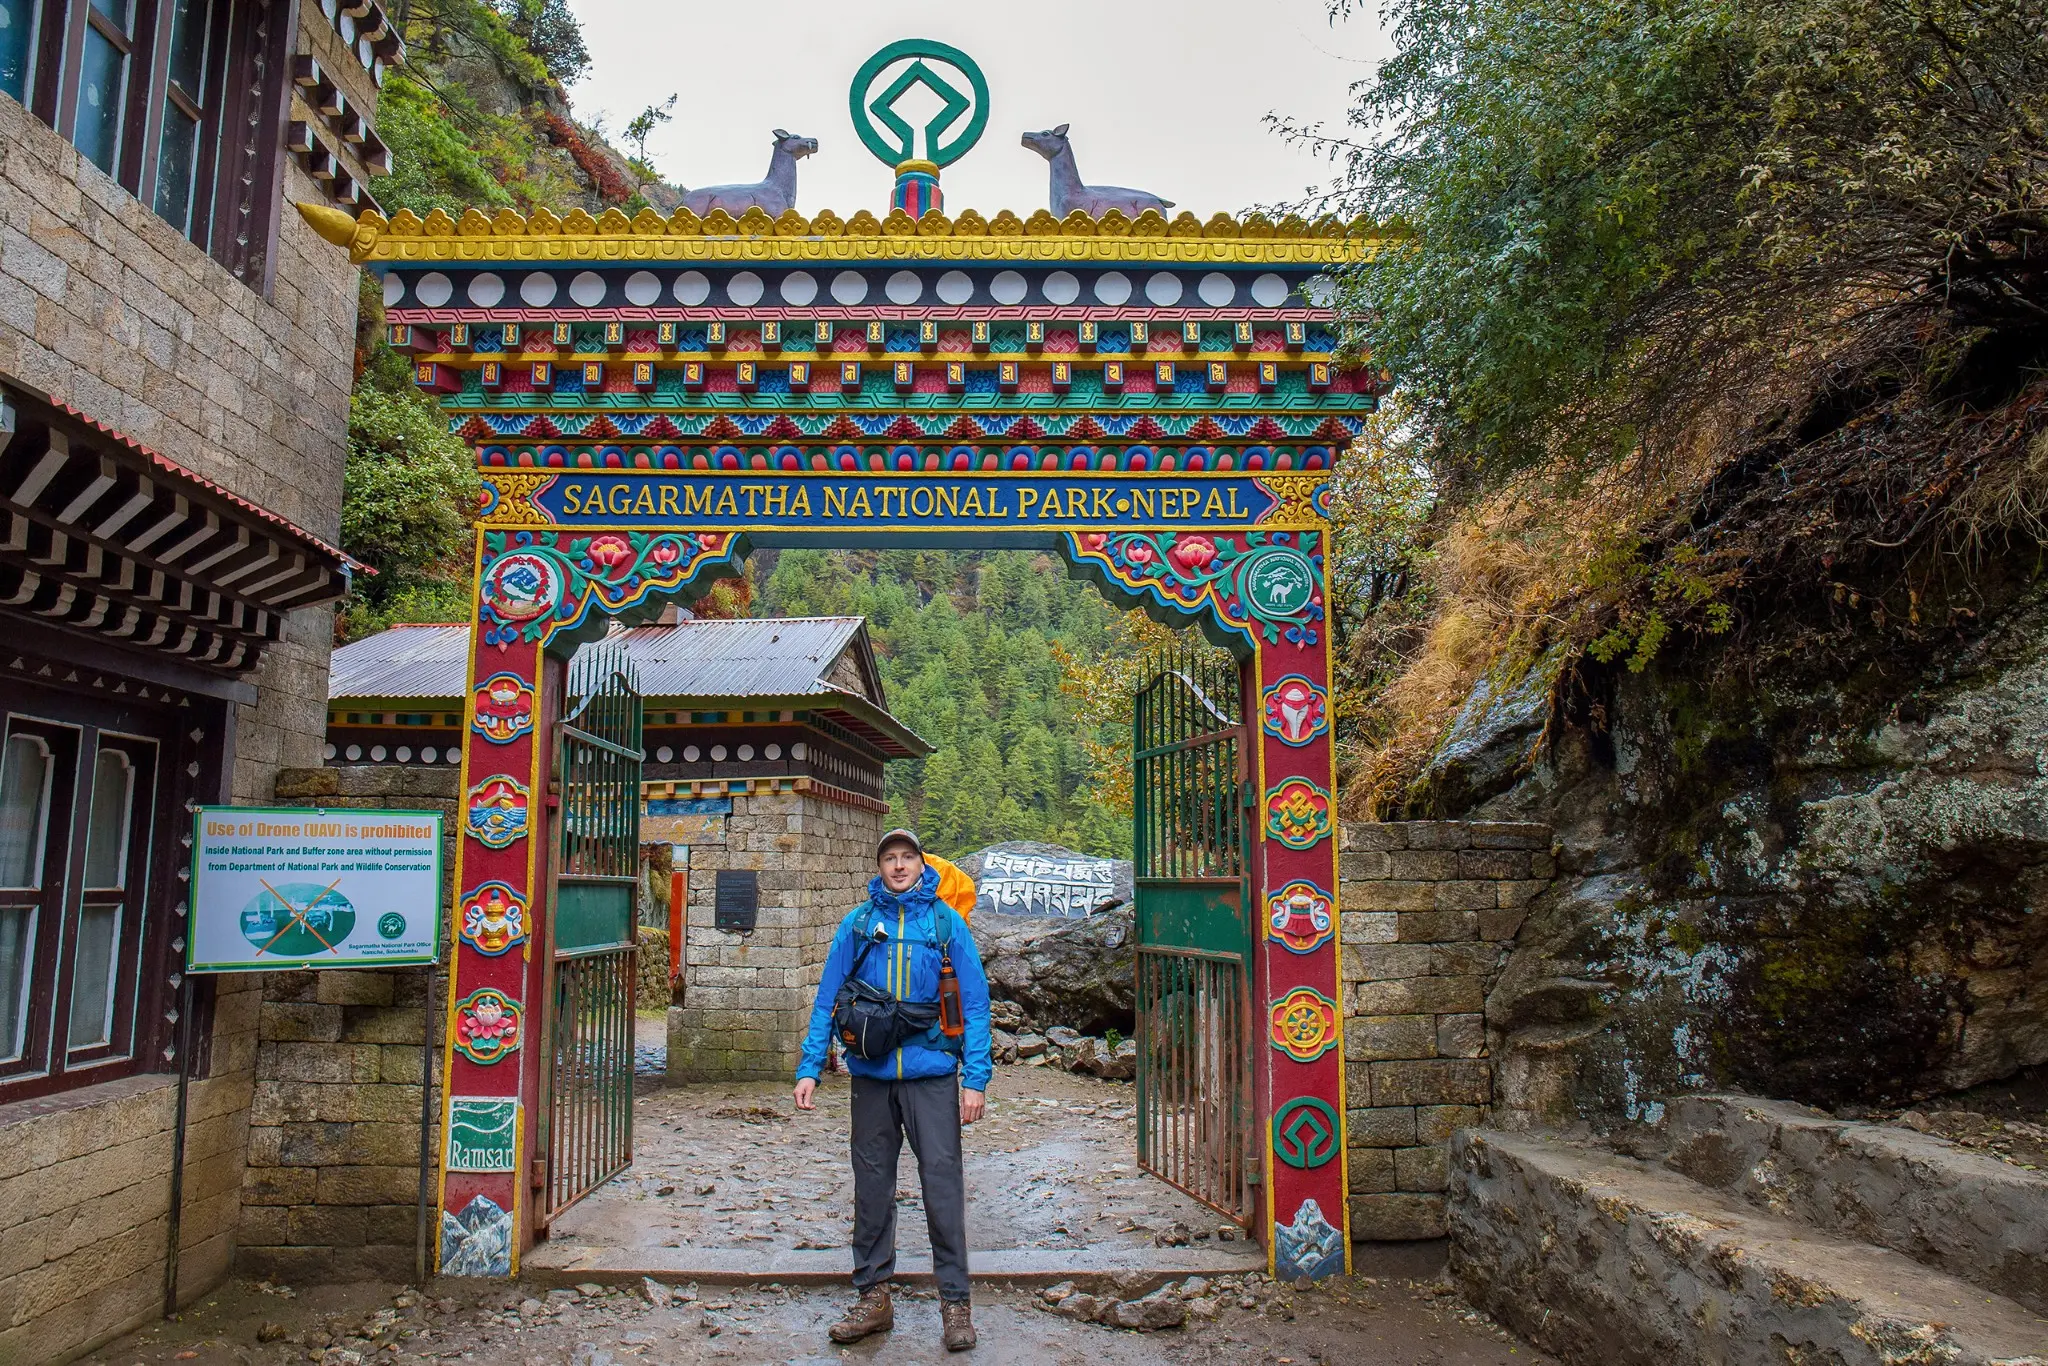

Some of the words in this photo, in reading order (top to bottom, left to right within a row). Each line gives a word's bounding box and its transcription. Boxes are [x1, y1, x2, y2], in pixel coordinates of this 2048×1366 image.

[563, 484, 813, 517] SAGARMATHA
[822, 486, 1008, 518] NATIONAL
[207, 821, 235, 836] Use
[238, 822, 253, 836] of
[256, 822, 300, 837] Drone
[304, 823, 342, 838] (UAV)
[345, 823, 358, 838] is
[361, 824, 432, 840] prohibited
[231, 846, 264, 855] National
[266, 846, 285, 855] Park
[286, 846, 300, 855] and
[302, 846, 326, 855] Buffer
[327, 848, 345, 856] zone
[346, 848, 363, 856] area
[365, 847, 392, 856] without
[393, 847, 433, 857] permission
[208, 862, 227, 871] from
[229, 862, 275, 873] Department
[277, 862, 286, 871] of
[287, 862, 319, 871] National
[321, 862, 339, 871] Park
[340, 862, 354, 871] and
[355, 862, 383, 871] Wildlife
[384, 862, 431, 871] Conservation
[452, 1140, 515, 1168] Ramsar
